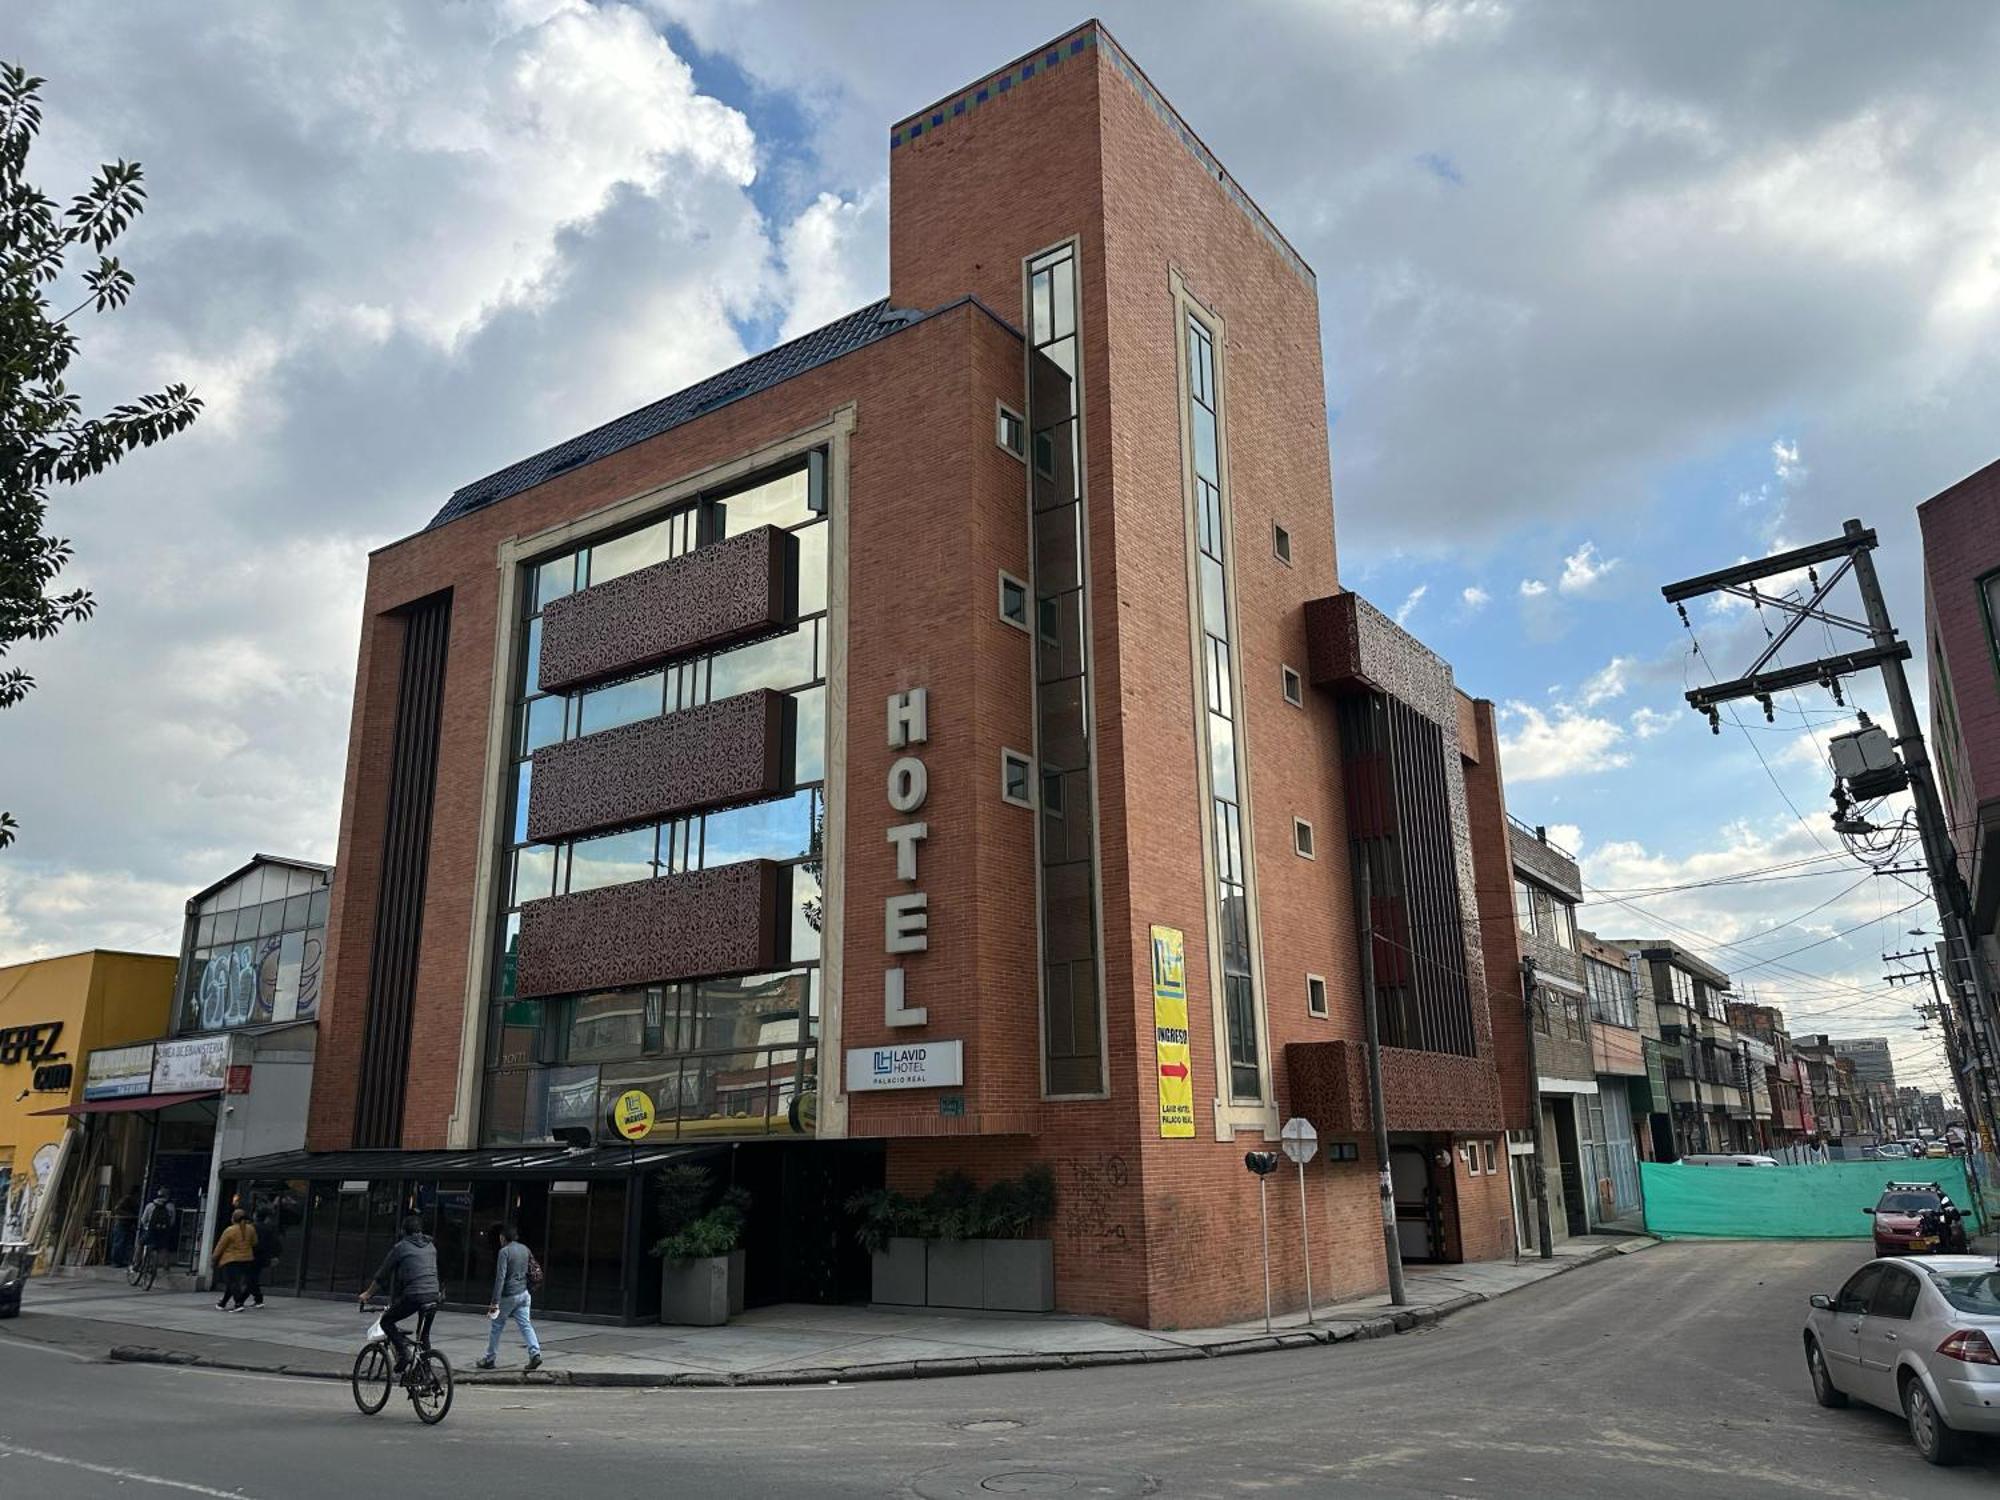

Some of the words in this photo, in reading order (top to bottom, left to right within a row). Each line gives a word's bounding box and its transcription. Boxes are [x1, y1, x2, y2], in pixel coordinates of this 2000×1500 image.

[885, 687, 928, 1028] HOTEL
[1157, 1027, 1187, 1044] INGRESO
[894, 1048, 926, 1062] LAVID
[894, 1062, 926, 1073] HOTEL
[874, 1077, 905, 1085] PALACIO
[907, 1075, 926, 1083] REAL
